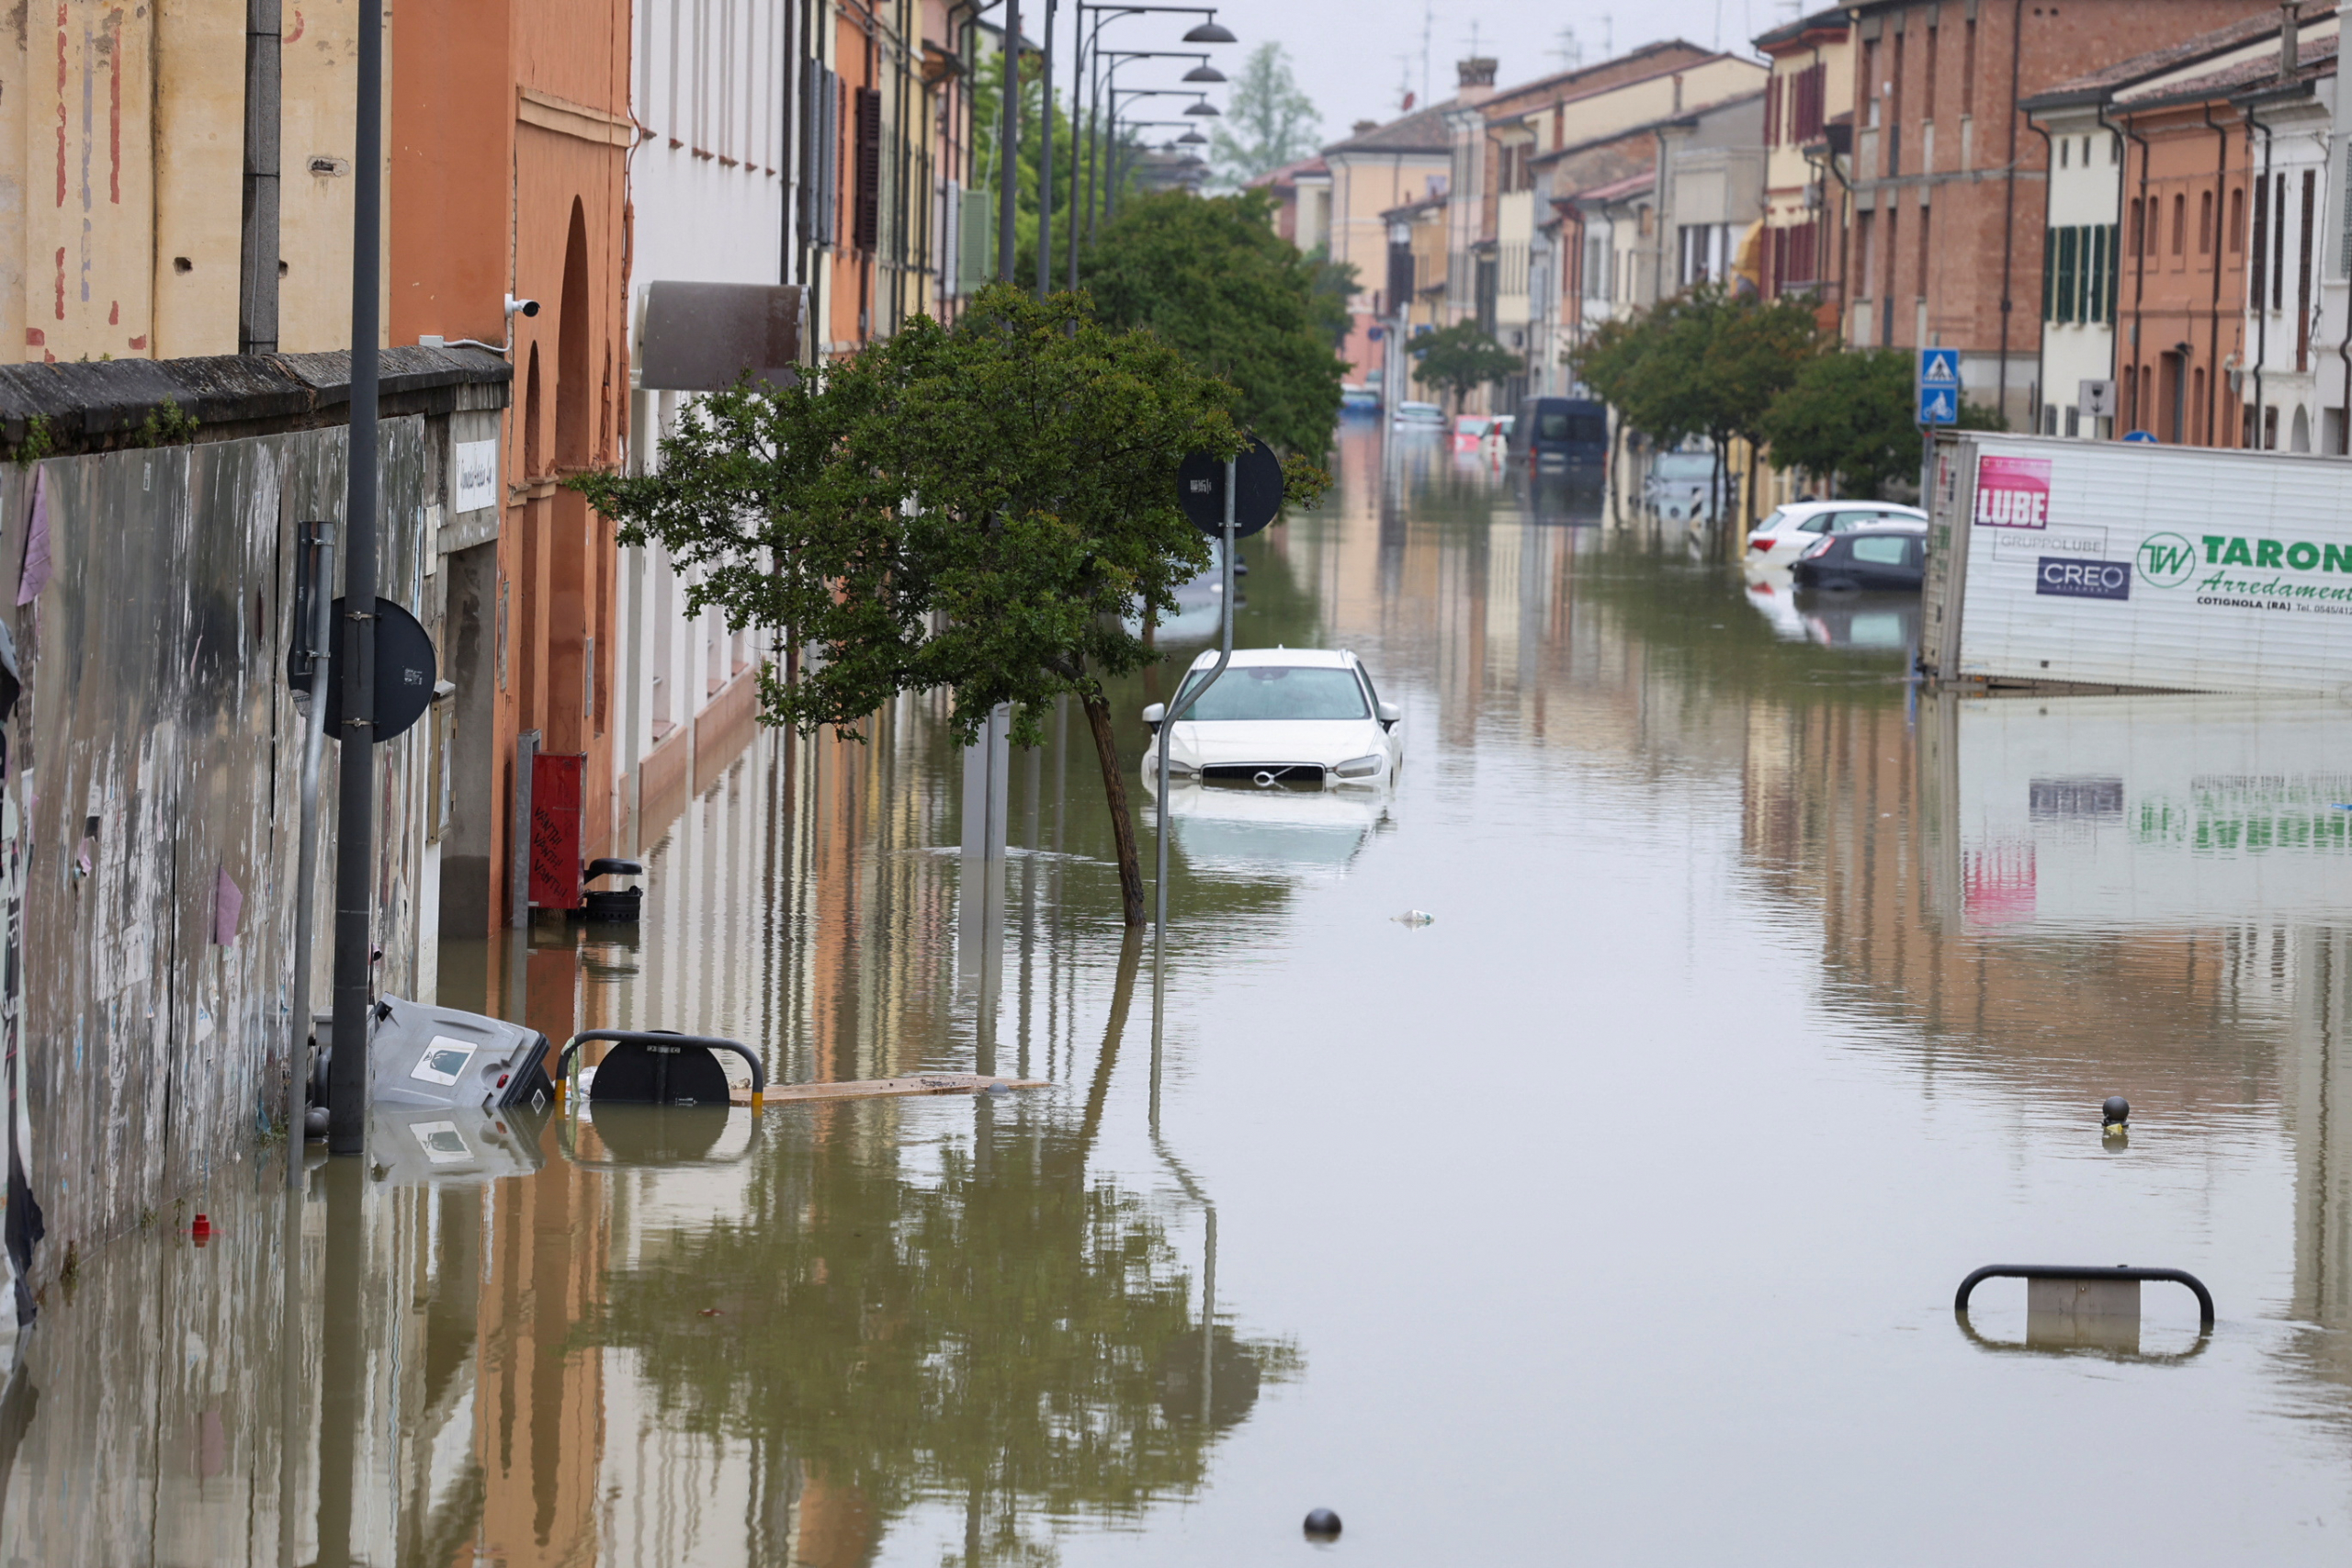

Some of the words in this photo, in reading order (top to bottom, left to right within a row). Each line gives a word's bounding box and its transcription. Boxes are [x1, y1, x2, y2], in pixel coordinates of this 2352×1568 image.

[1977, 488, 2047, 527] LUBE
[2001, 535, 2102, 553] GRUPPOLUBE
[2202, 535, 2352, 573] TARON
[2043, 562, 2124, 589] CREO
[2197, 596, 2263, 608] COTIGNOLA
[2267, 600, 2291, 612] (RA)
[2297, 604, 2312, 613] Tel.
